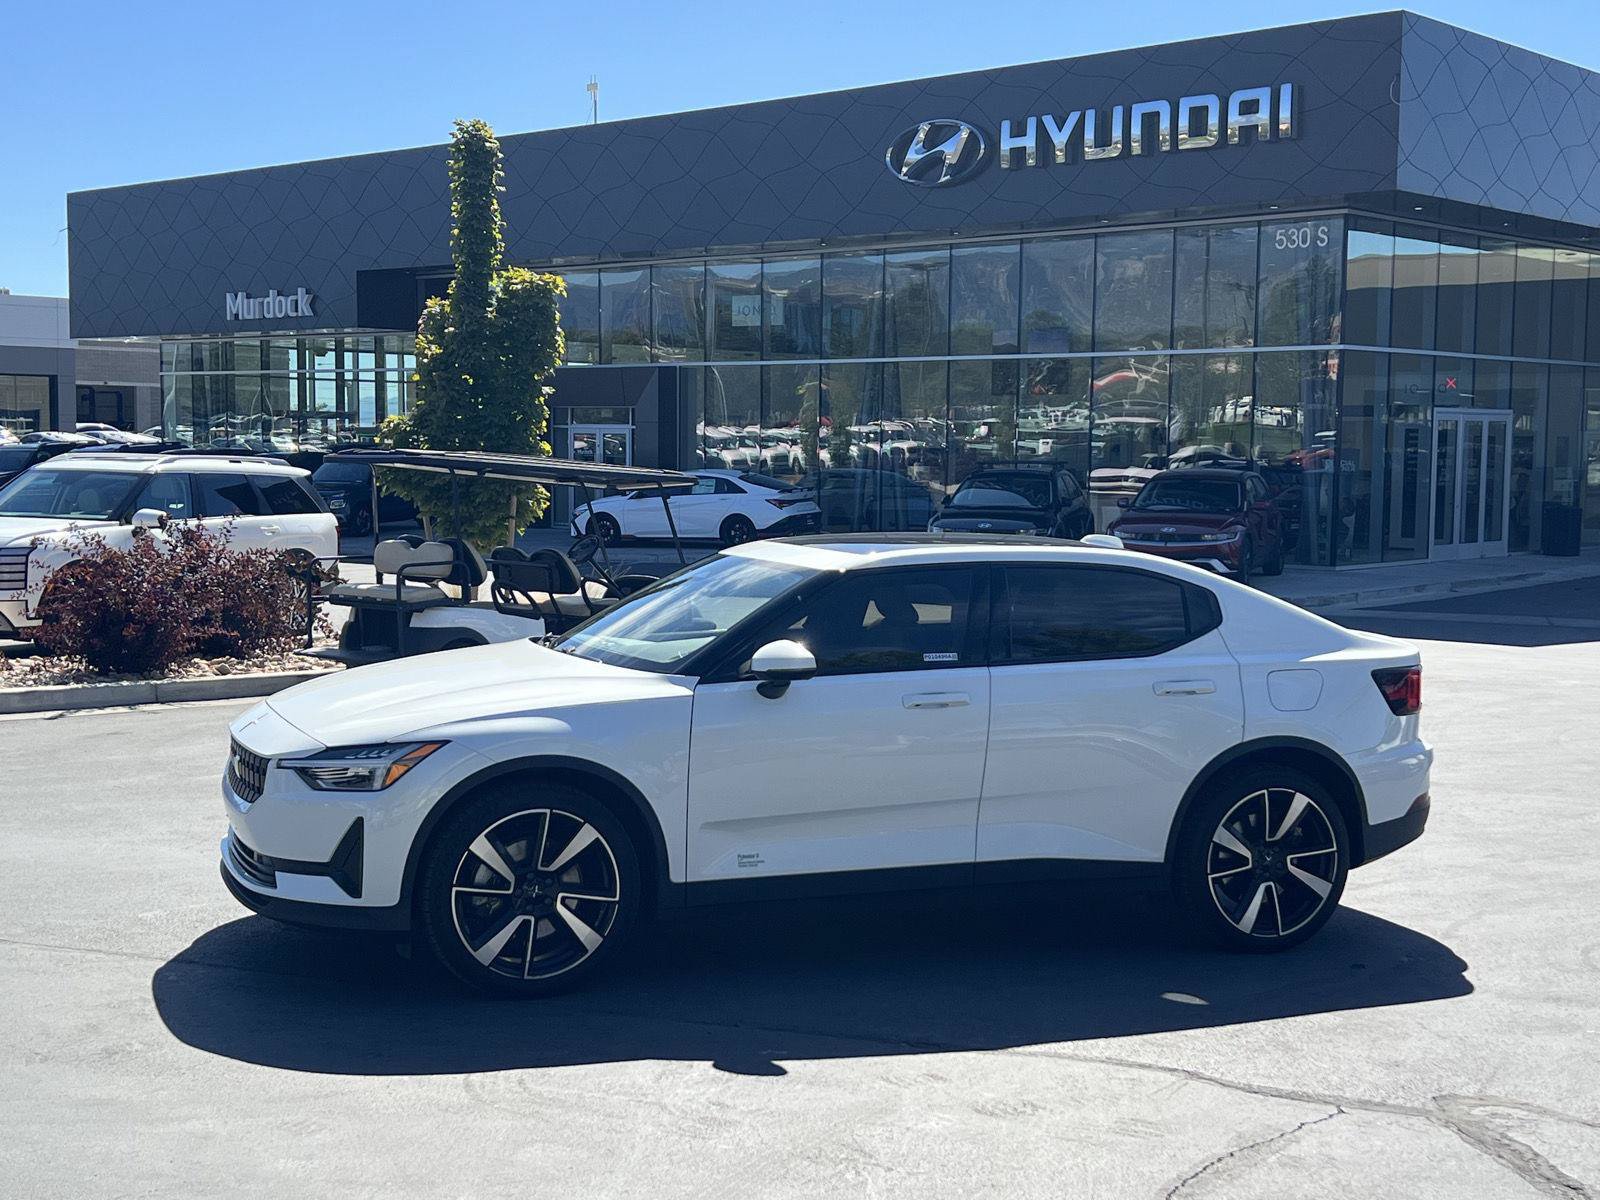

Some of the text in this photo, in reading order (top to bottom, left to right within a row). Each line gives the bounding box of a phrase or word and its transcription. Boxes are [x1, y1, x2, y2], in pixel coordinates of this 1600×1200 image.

[999, 82, 1293, 169] HYUNDAI
[1275, 226, 1328, 249] 530 S
[226, 287, 314, 321] Murdock
